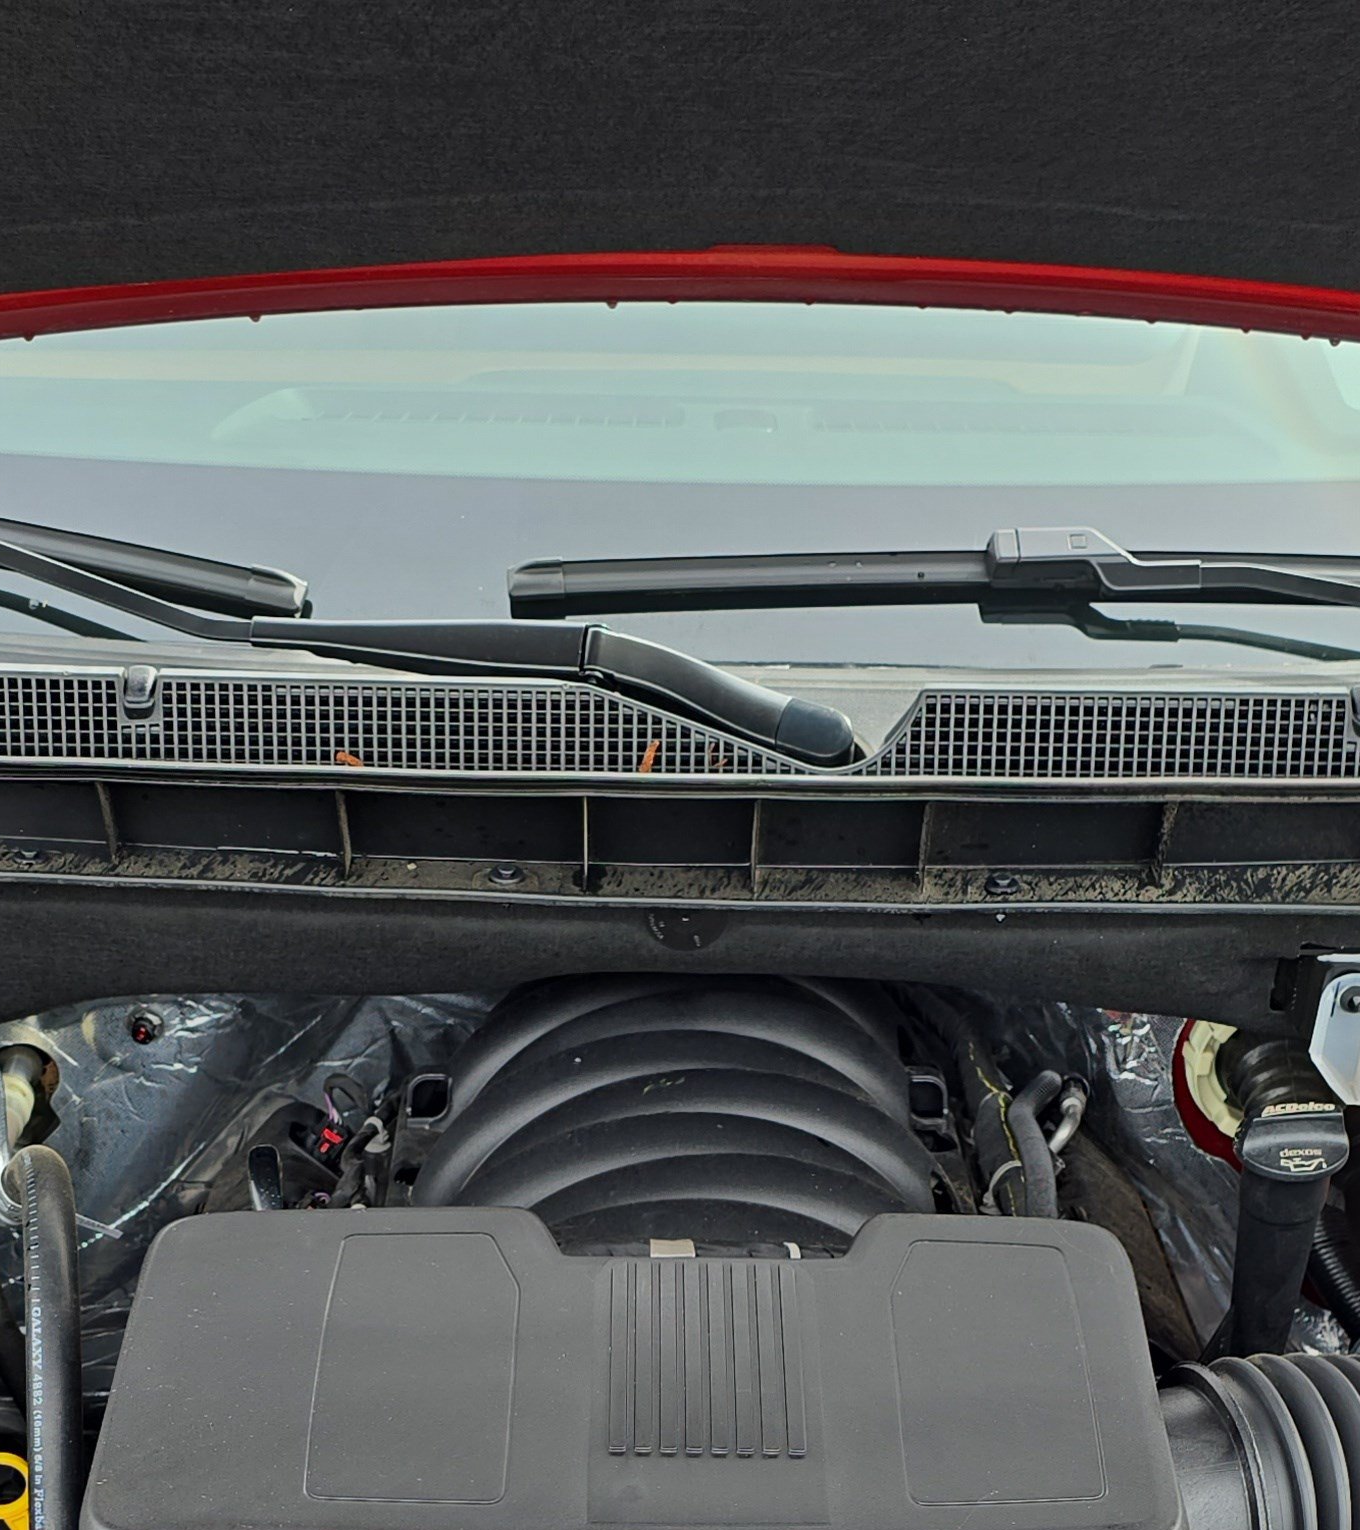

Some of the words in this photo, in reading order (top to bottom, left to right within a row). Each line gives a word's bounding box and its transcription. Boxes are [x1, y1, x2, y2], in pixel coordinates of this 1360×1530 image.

[1261, 1101, 1336, 1118] ACDelco
[1279, 1148, 1322, 1158] dexos
[31, 1306, 42, 1370] GALAXY
